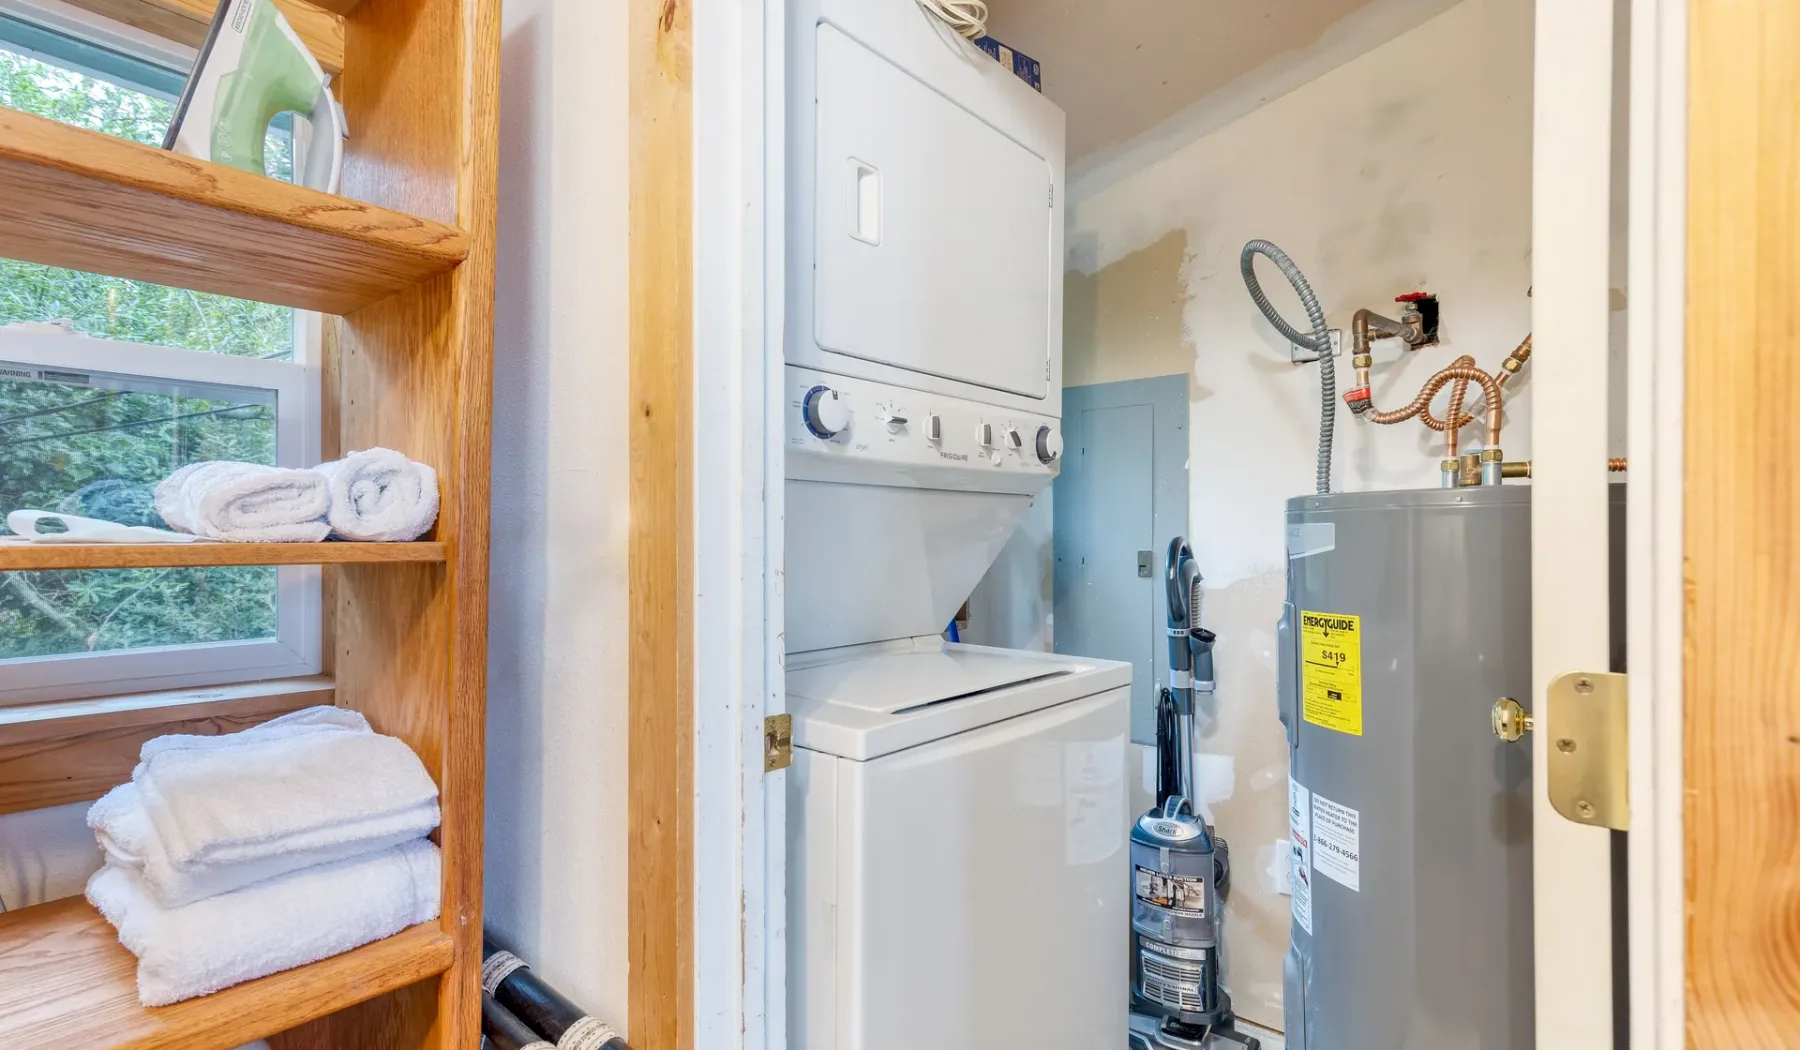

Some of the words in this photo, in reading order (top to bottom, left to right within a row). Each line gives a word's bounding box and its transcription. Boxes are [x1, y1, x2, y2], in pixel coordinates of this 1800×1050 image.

[940, 452, 968, 462] FRIGIDAIRE
[1321, 649, 1346, 663] $419
[1348, 819, 1358, 828] THE
